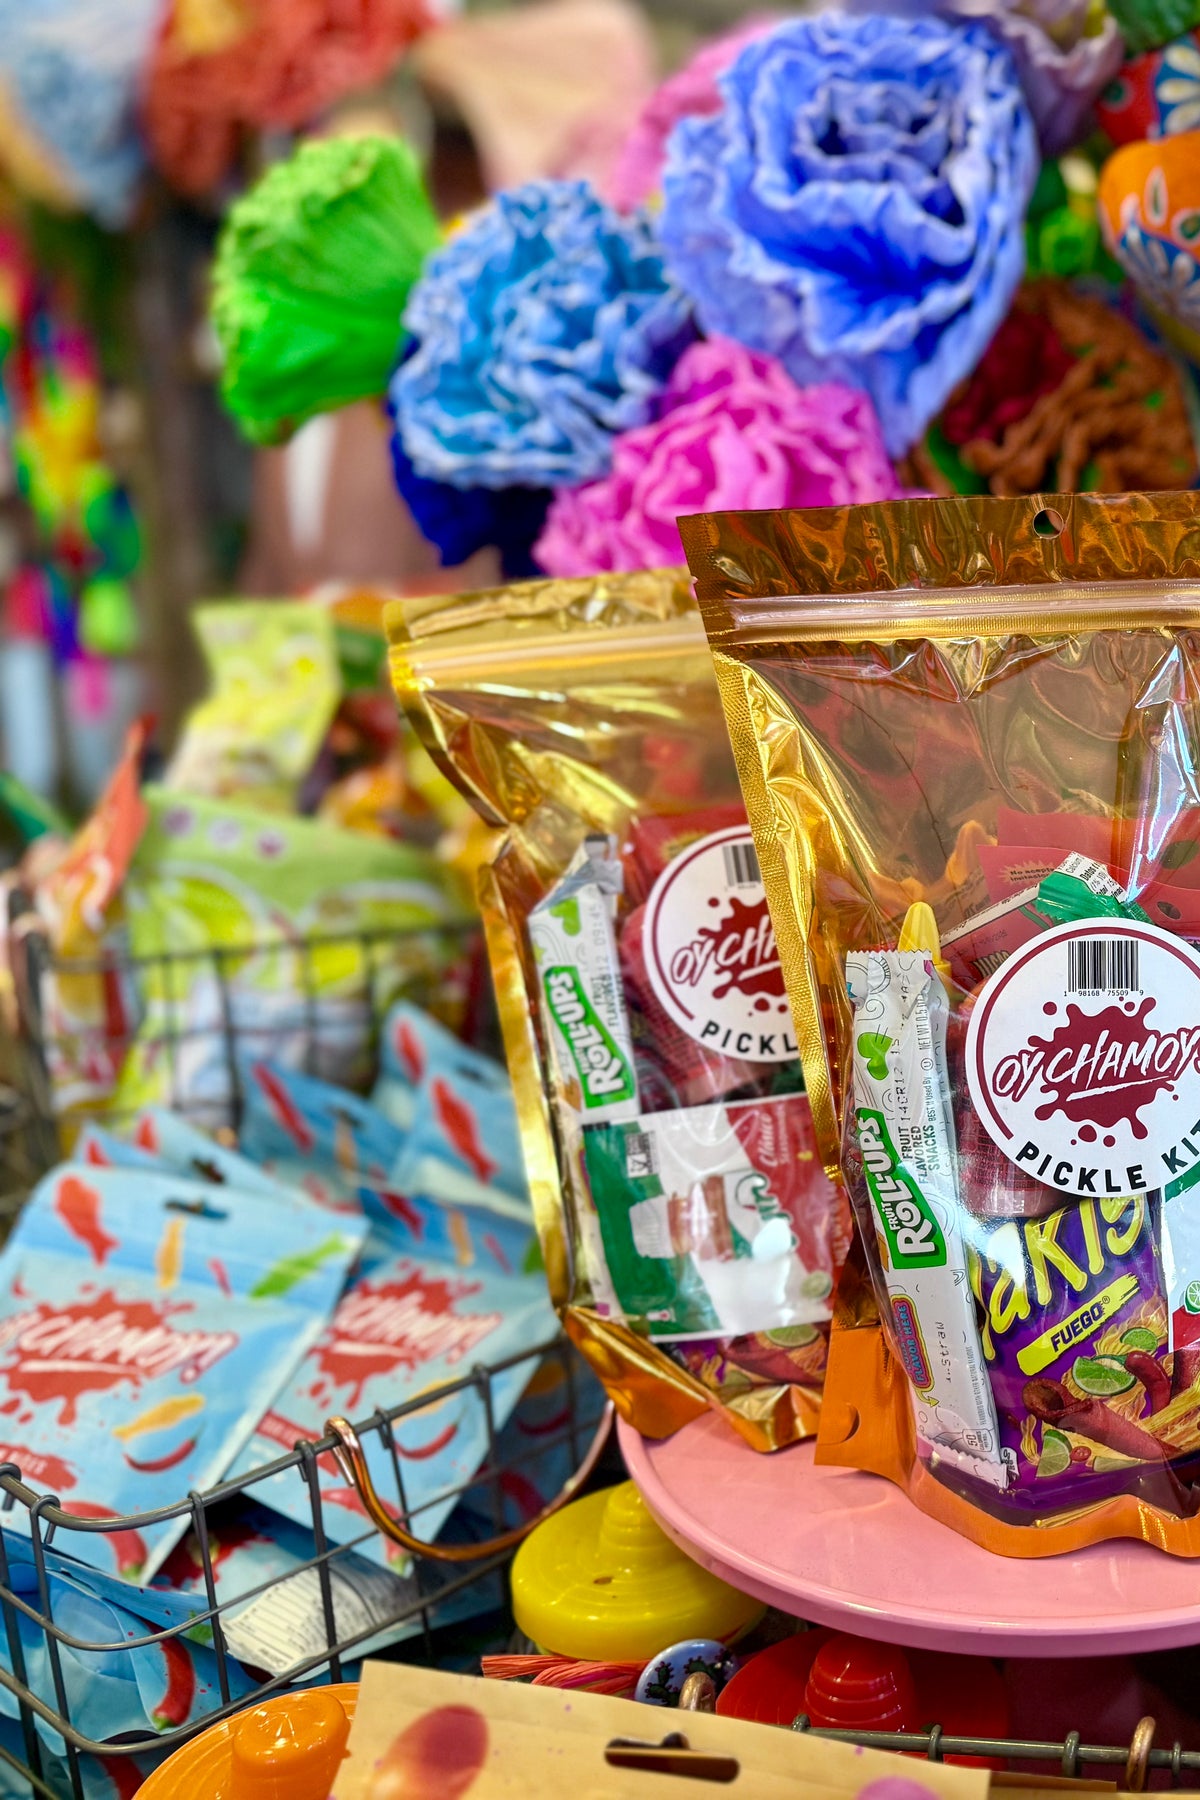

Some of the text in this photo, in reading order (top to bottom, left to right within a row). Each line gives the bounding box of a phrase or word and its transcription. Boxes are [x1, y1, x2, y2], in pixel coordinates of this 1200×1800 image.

[671, 939, 714, 987] OY
[1107, 989, 1129, 997] 75509
[701, 1021, 798, 1055] PICKL
[993, 1050, 1045, 1102] OY
[897, 1126, 914, 1160] FRUIT
[910, 1126, 930, 1185] FLAVORED
[922, 1124, 940, 1172] SNACKS
[1015, 1141, 1147, 1193] PICKLE
[881, 1202, 901, 1231] FRUIT
[899, 1304, 913, 1335] HERE
[1050, 1300, 1104, 1353] FUEGO
[966, 1434, 978, 1447] 50
